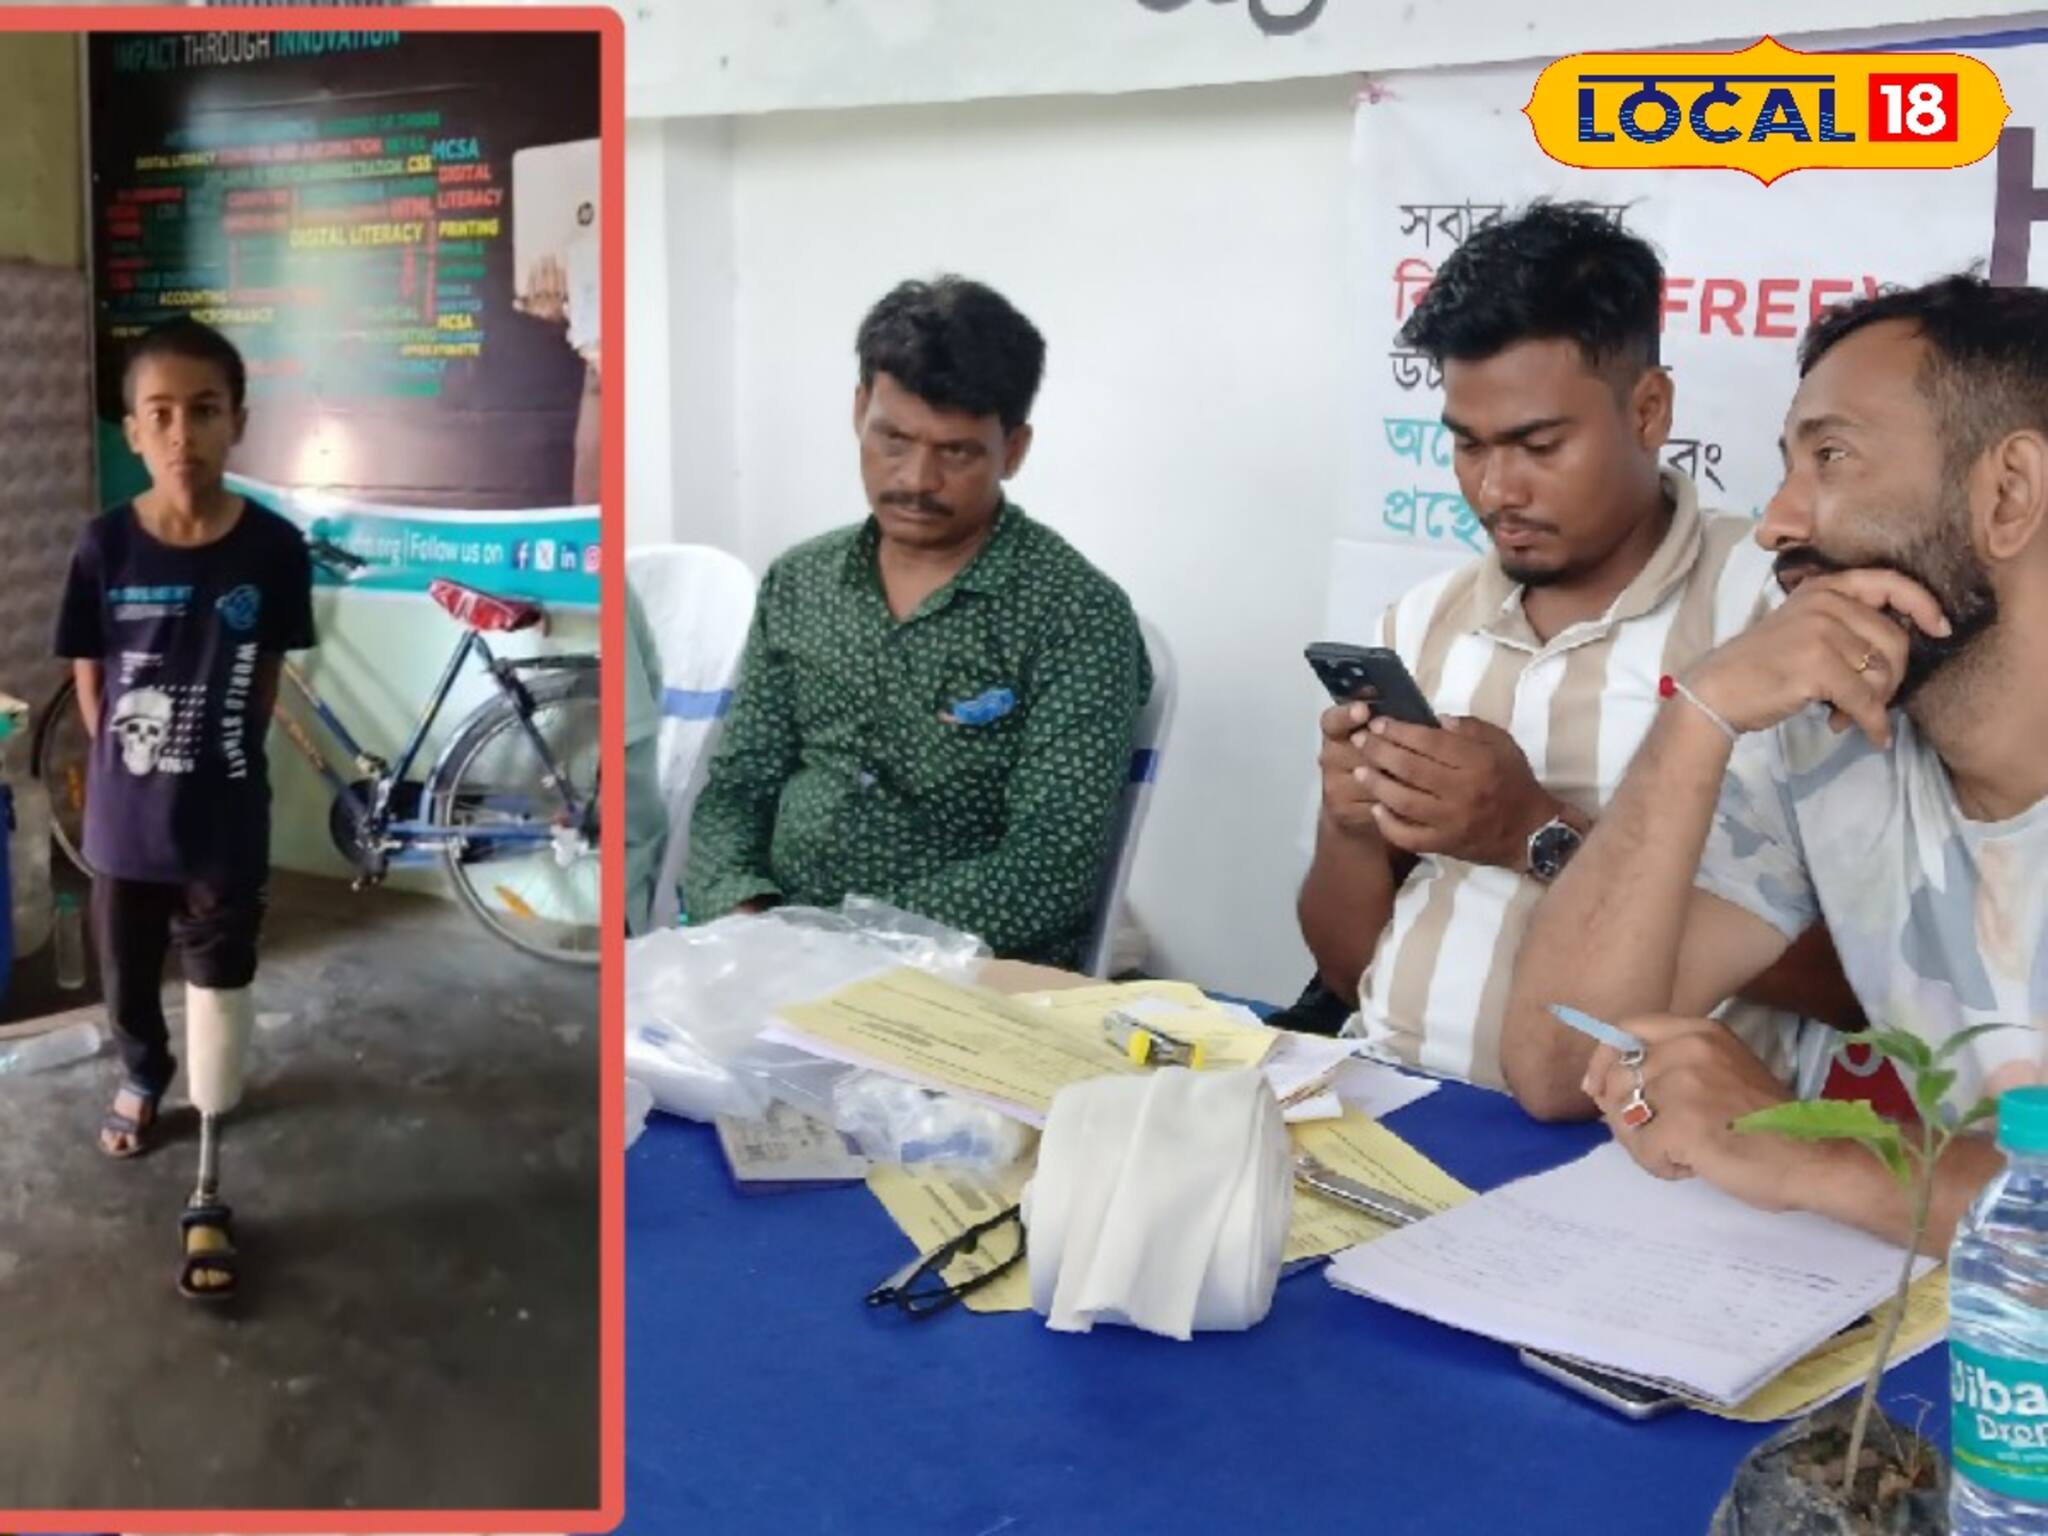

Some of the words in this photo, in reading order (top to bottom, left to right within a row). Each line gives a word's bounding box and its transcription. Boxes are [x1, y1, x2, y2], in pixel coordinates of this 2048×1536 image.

[114, 36, 176, 70] IMPACT
[182, 31, 270, 66] THROUGH
[432, 138, 479, 159] MCSA
[438, 163, 490, 182] DIGITAL
[438, 188, 503, 208] LITERACY
[289, 225, 347, 249] DIGITAL
[350, 222, 424, 245] LITERACY
[410, 531, 459, 563] Follow
[461, 542, 481, 564] us
[483, 543, 503, 564] on
